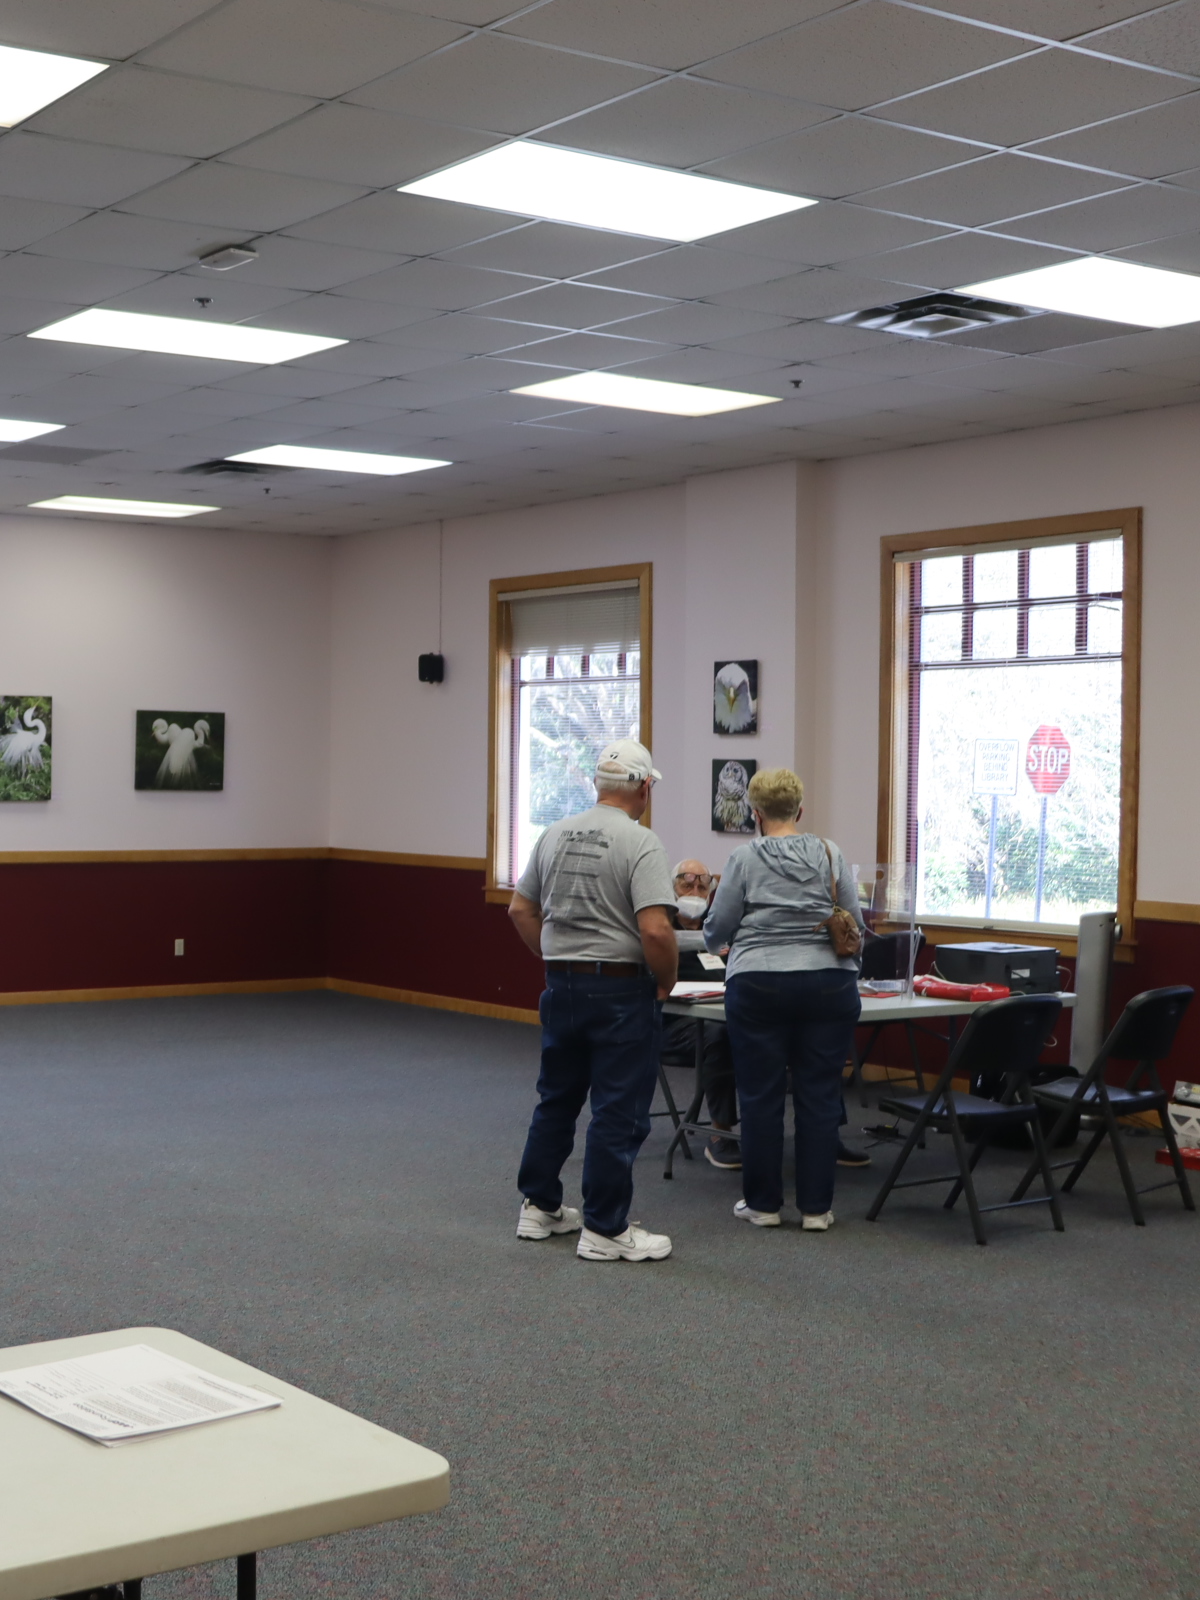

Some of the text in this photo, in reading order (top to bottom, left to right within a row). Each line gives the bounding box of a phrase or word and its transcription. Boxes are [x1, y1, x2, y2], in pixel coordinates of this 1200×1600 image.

[978, 742, 1014, 751] OVERFLOW
[982, 752, 1010, 762] PARKING
[1028, 745, 1068, 774] STOP
[981, 773, 1008, 782] LIBRARY
